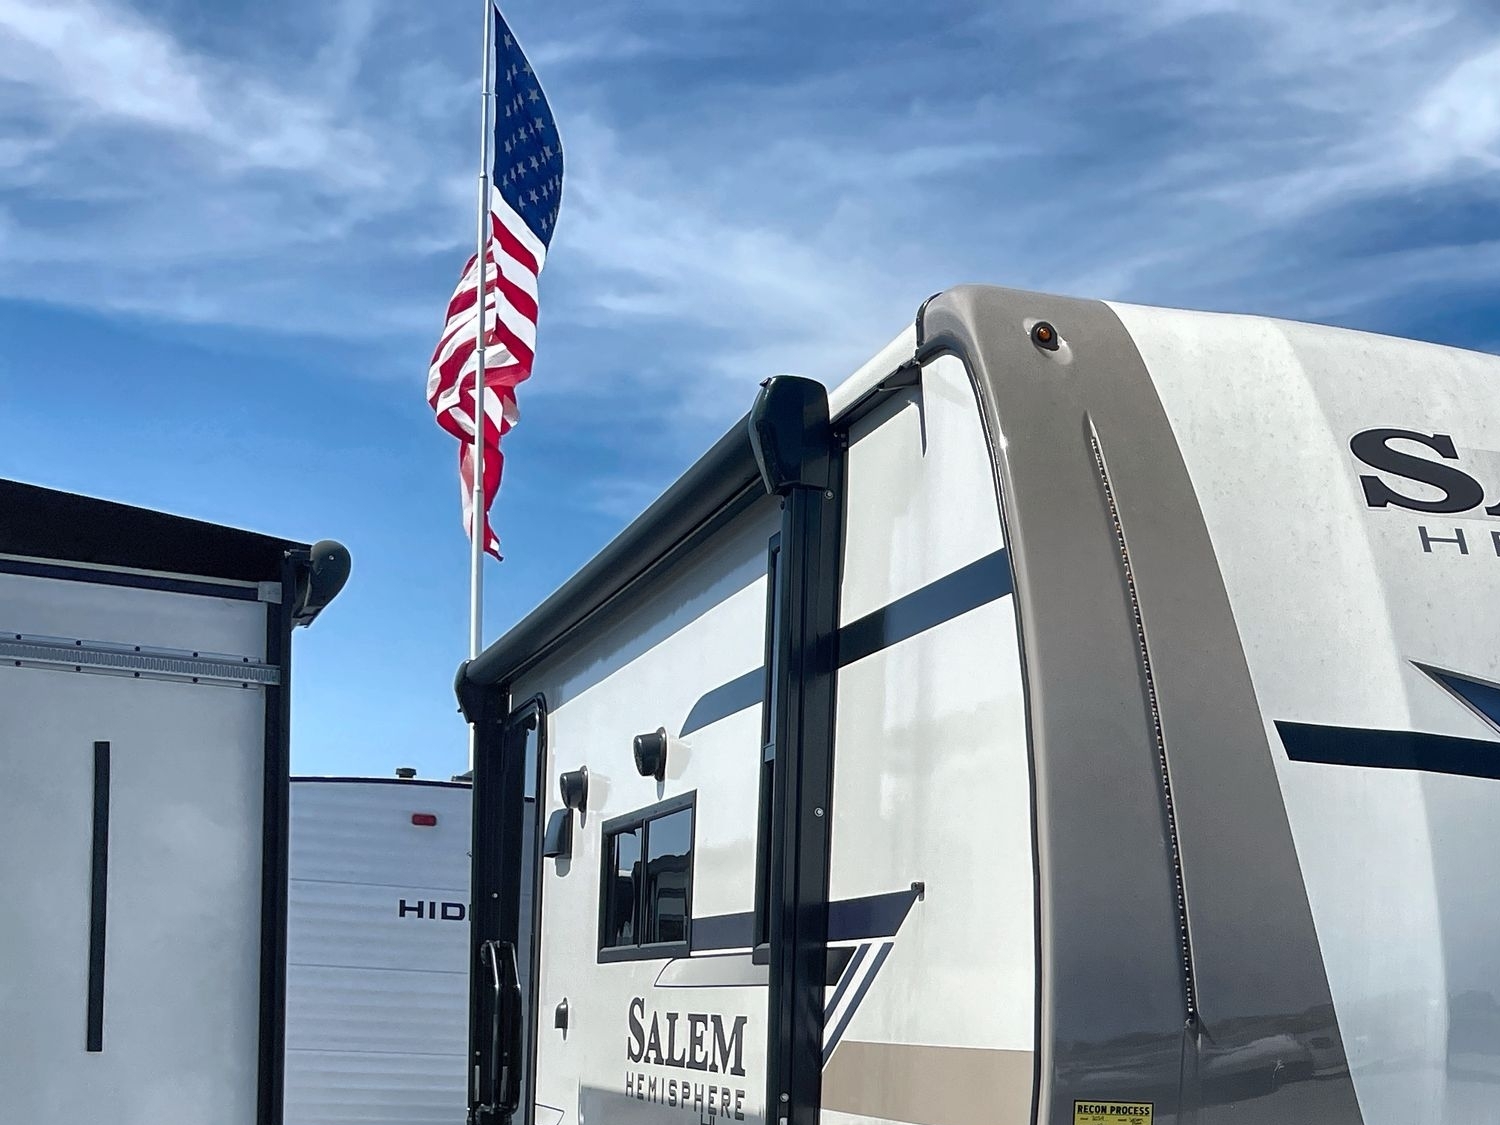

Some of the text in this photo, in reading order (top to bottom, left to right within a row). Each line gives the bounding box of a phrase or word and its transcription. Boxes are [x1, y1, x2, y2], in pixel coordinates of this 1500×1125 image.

[399, 899, 471, 921] HID
[627, 997, 748, 1077] SALEM
[625, 1071, 746, 1121] HEMISPHERE
[1077, 1104, 1150, 1116] RECON PROCESS
